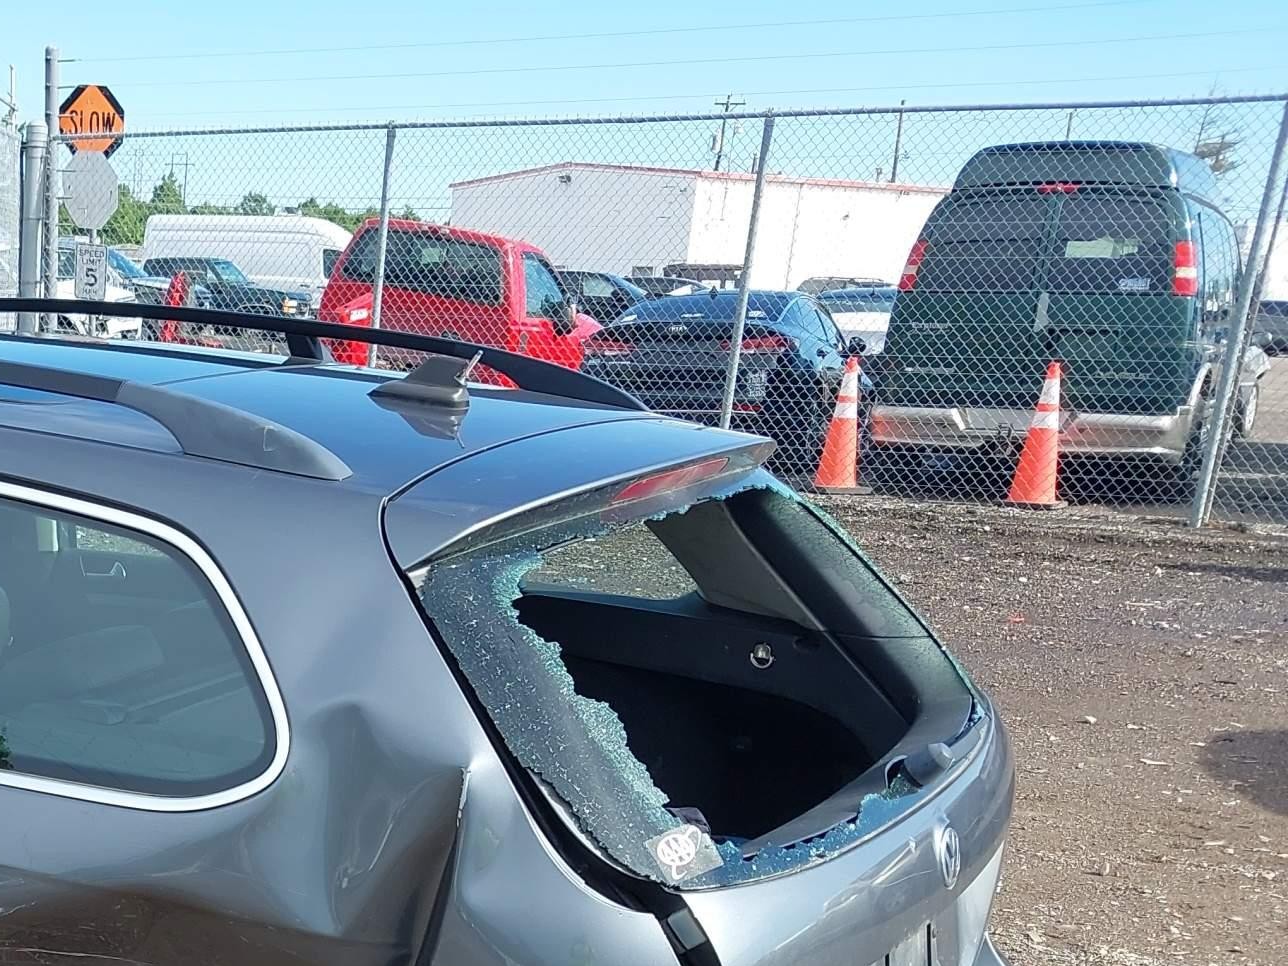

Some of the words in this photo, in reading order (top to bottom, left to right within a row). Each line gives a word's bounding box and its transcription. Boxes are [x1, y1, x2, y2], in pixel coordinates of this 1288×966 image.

[69, 109, 116, 135] SLOW
[79, 248, 104, 258] SPEED
[81, 257, 101, 266] LIMIT
[84, 267, 98, 287] 5
